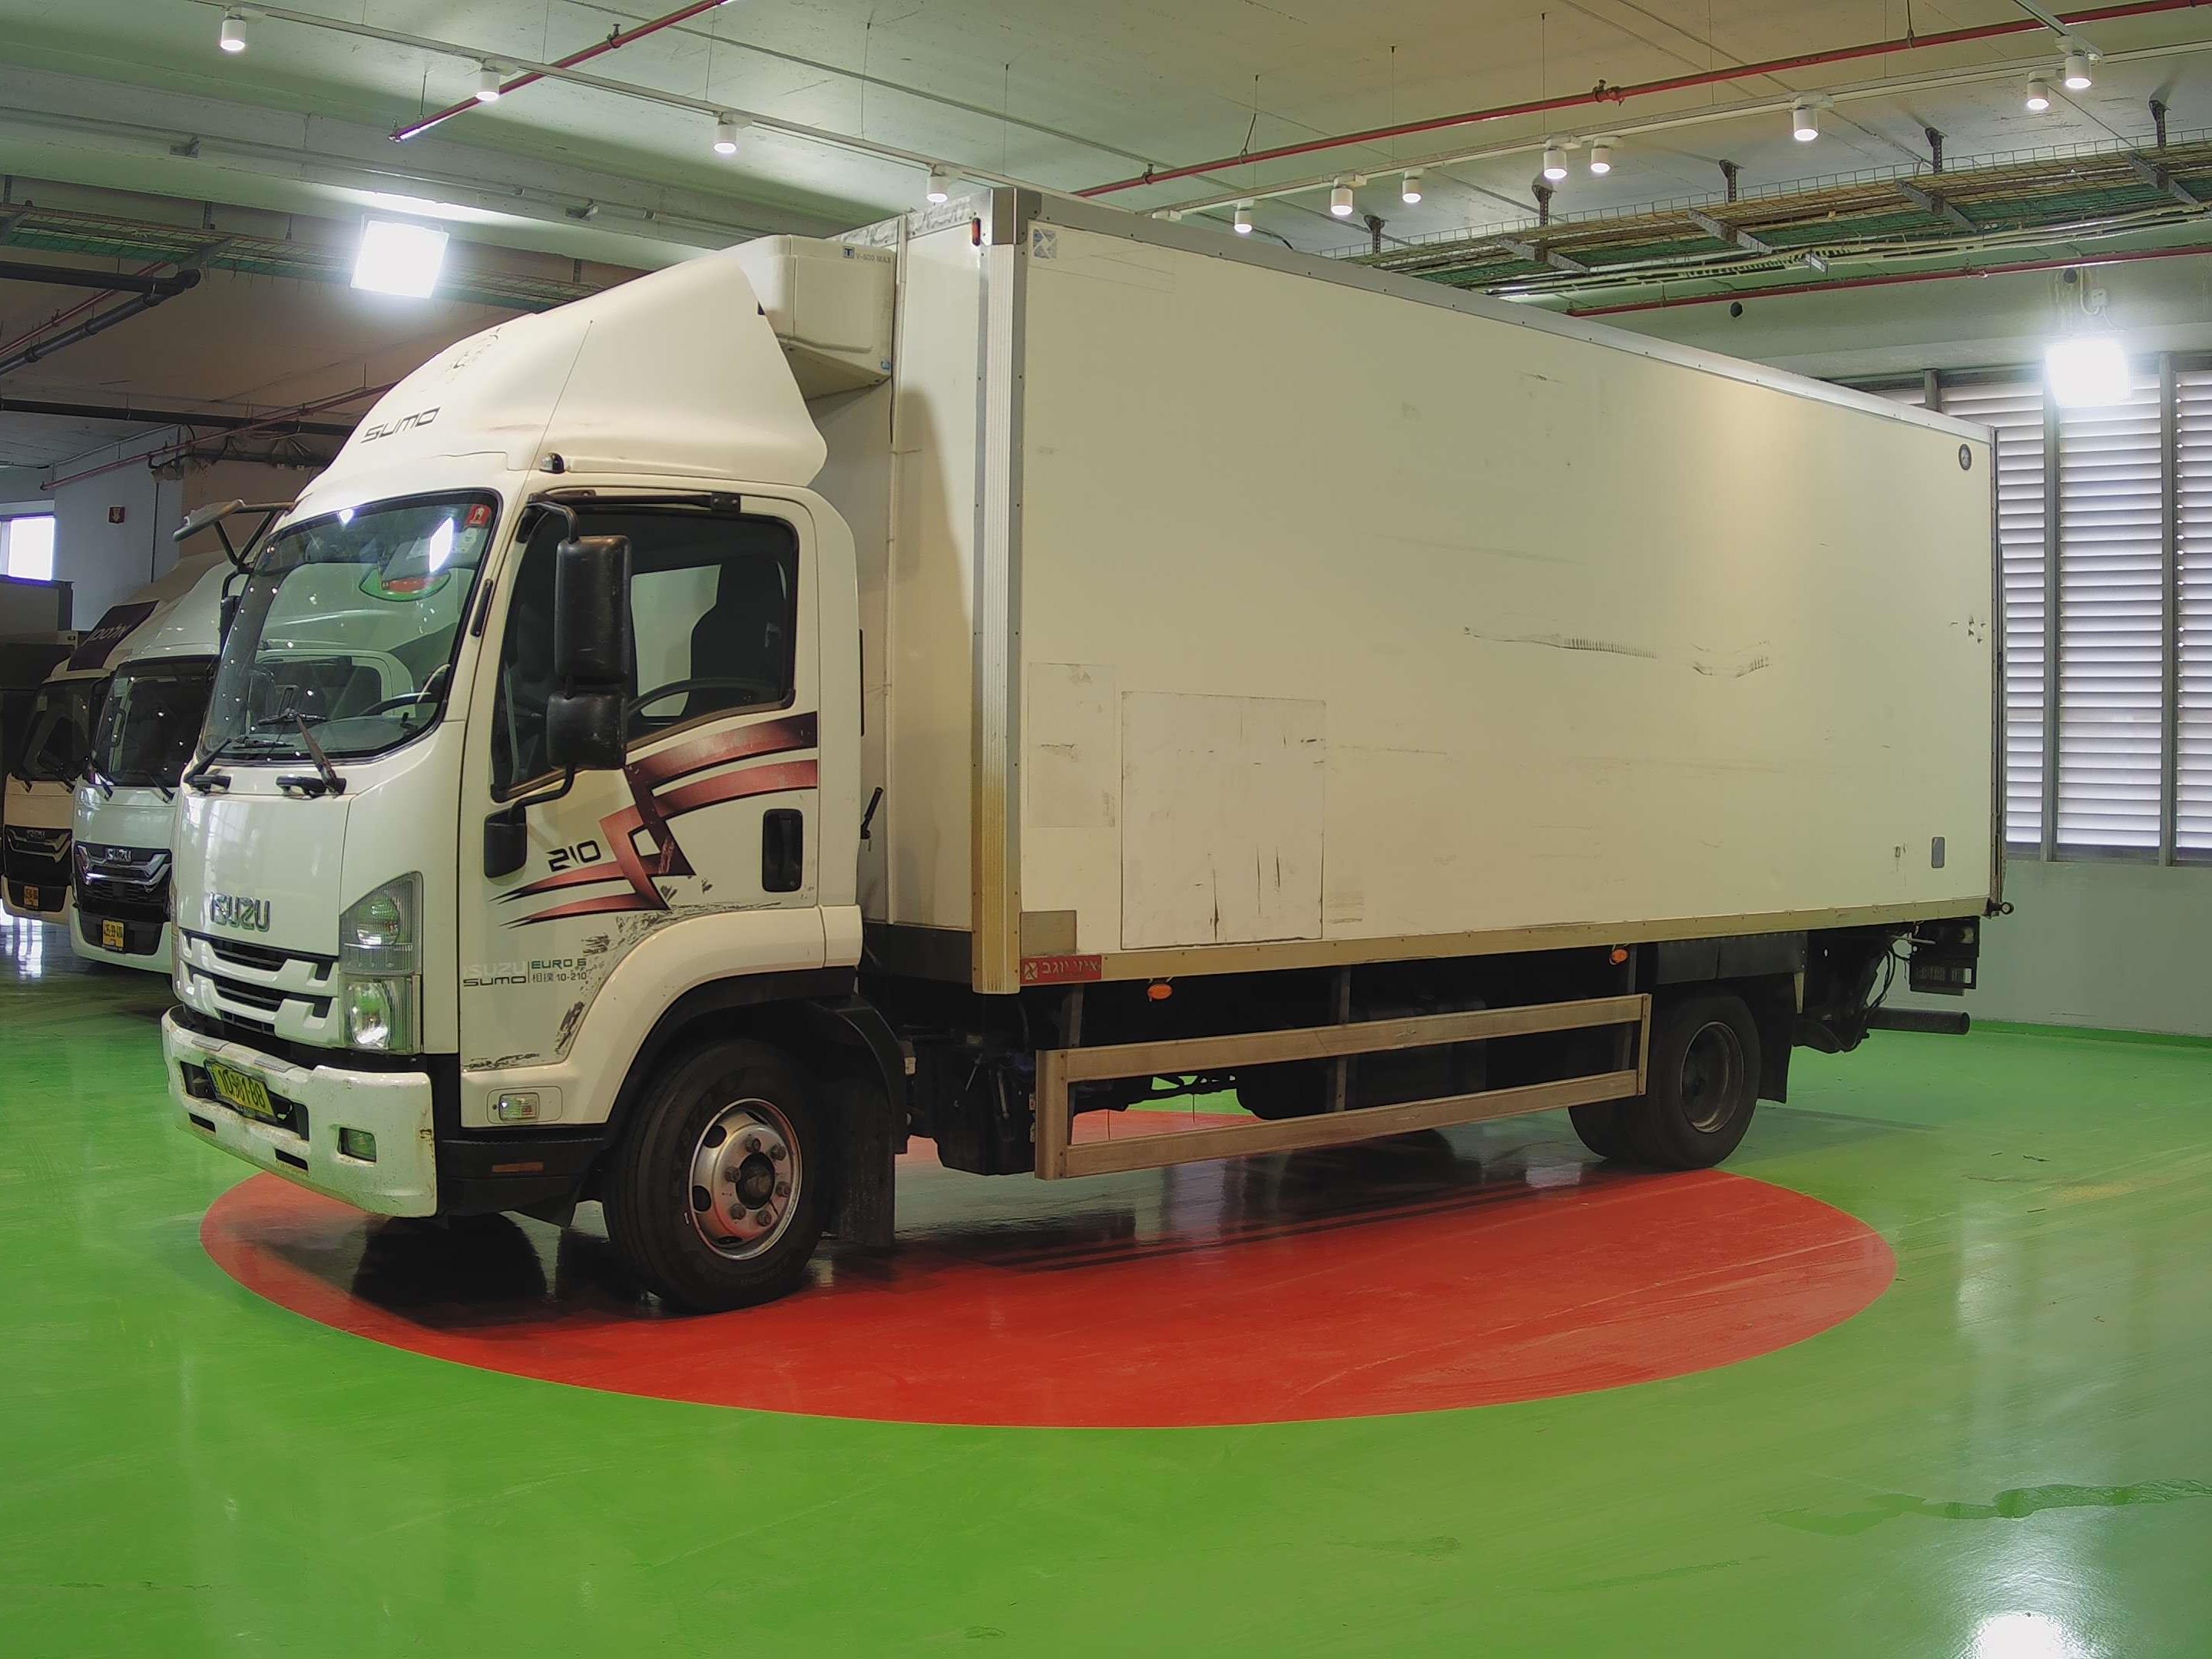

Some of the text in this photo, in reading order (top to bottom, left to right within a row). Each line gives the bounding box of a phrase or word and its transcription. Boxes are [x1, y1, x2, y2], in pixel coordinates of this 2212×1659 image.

[360, 406, 441, 444] SUMO
[104, 847, 132, 861] ISUZU
[546, 839, 601, 873] 210
[210, 892, 270, 932] ISUZU
[531, 959, 573, 970] EURO
[463, 975, 526, 987] SUMO
[556, 972, 587, 982] 10-210
